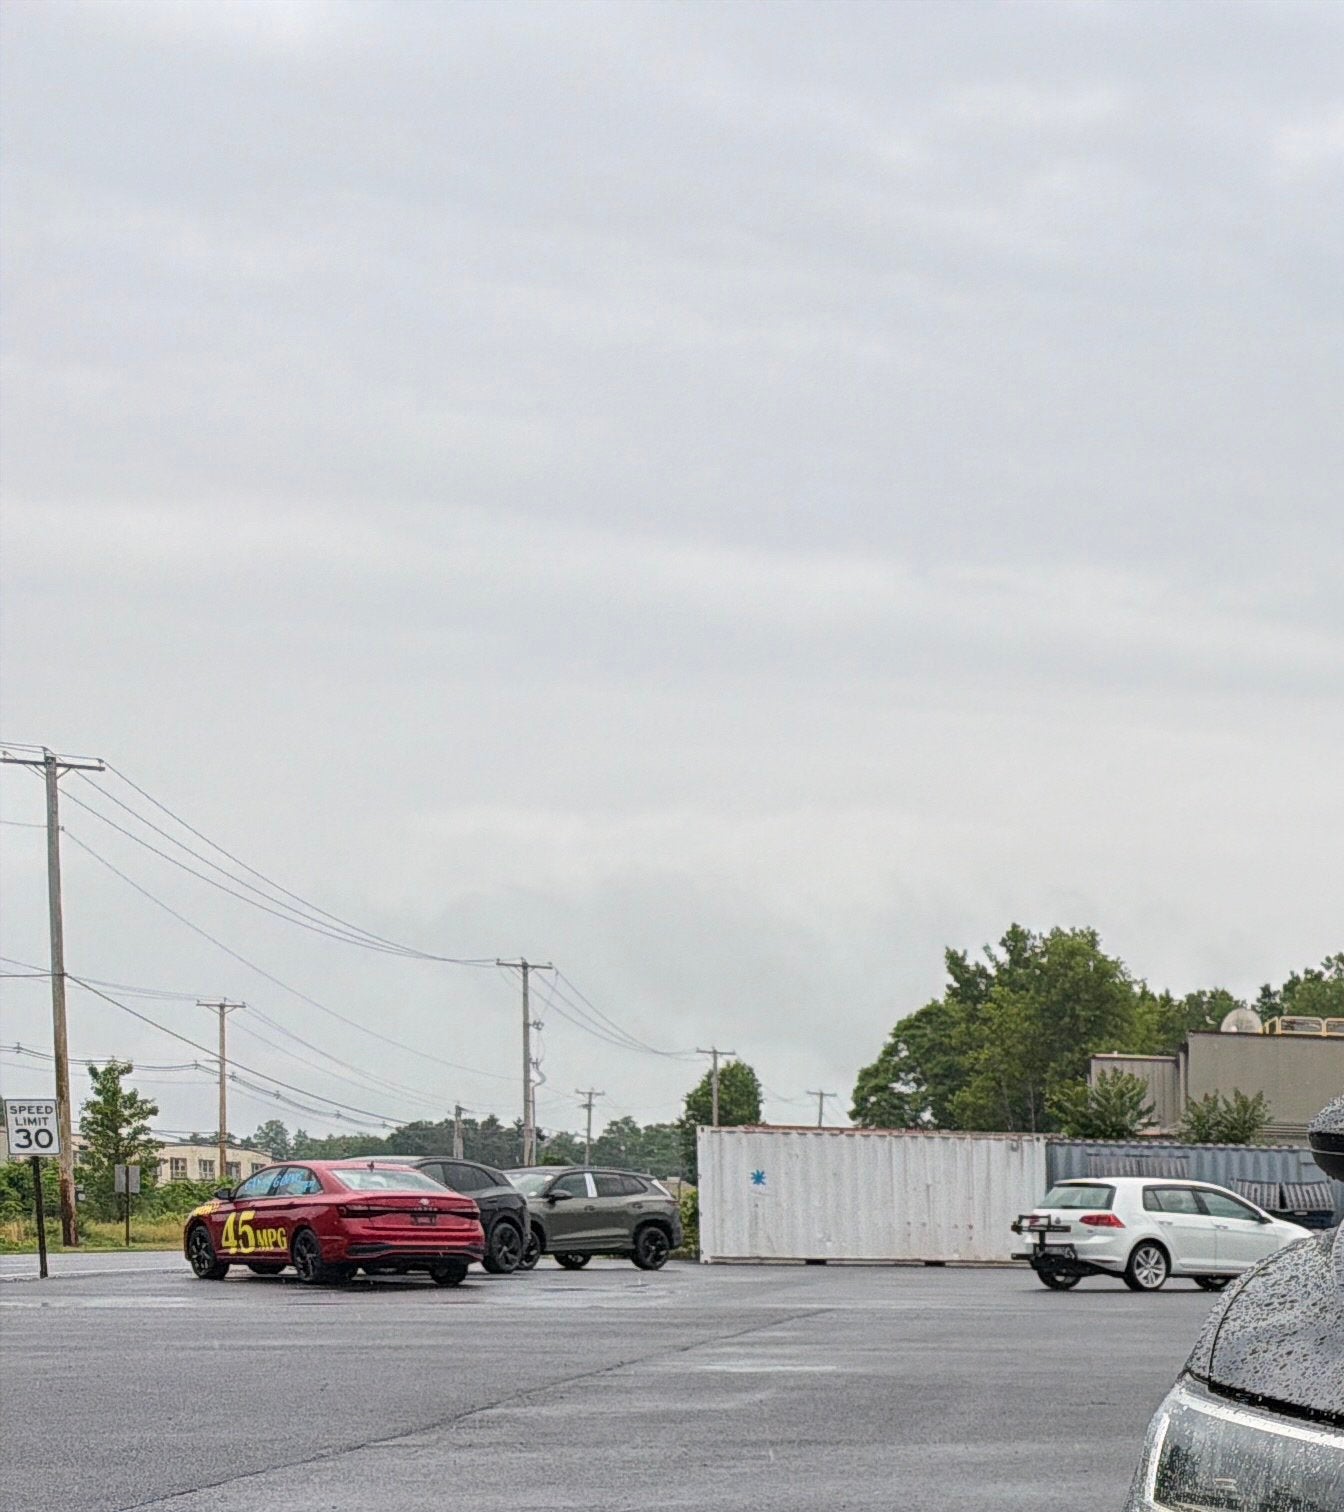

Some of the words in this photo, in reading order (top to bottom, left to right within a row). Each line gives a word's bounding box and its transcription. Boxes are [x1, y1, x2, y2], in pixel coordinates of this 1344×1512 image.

[9, 1105, 54, 1115] SPEED
[15, 1116, 49, 1126] LIMIT
[15, 1128, 53, 1148] 30
[221, 1210, 256, 1254] 45
[256, 1227, 288, 1252] MPG
